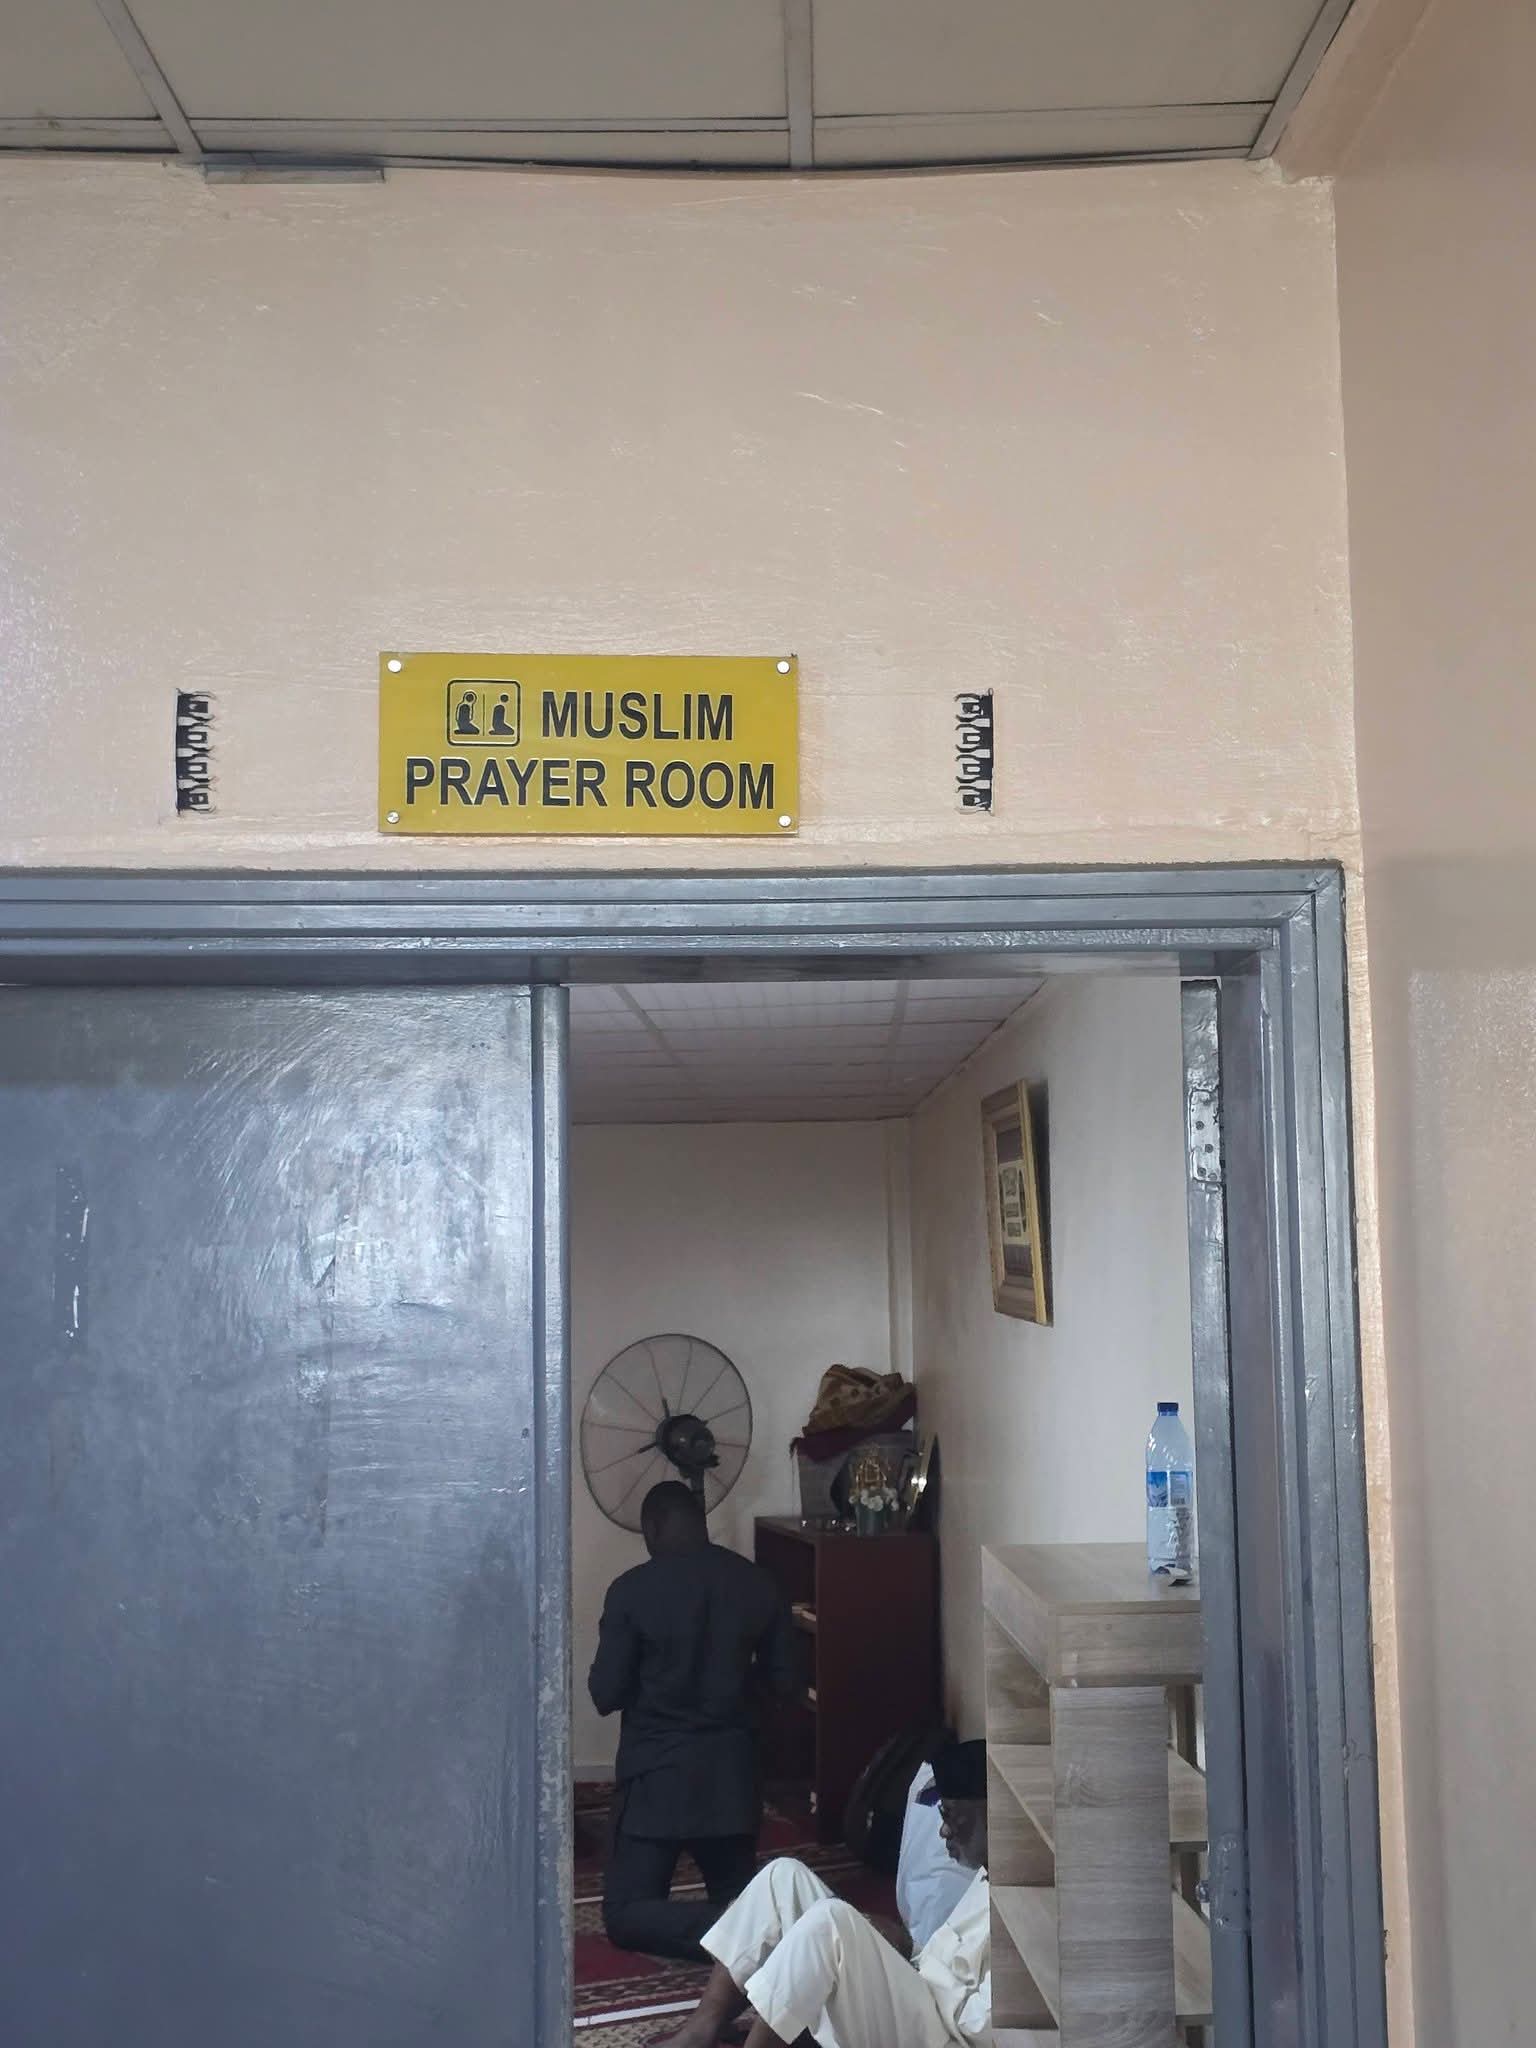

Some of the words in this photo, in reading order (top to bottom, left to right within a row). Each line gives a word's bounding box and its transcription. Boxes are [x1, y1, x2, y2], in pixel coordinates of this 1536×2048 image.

[542, 691, 733, 740] MUSLIM
[406, 757, 608, 807] PRAYER
[625, 761, 775, 809] ROOM
